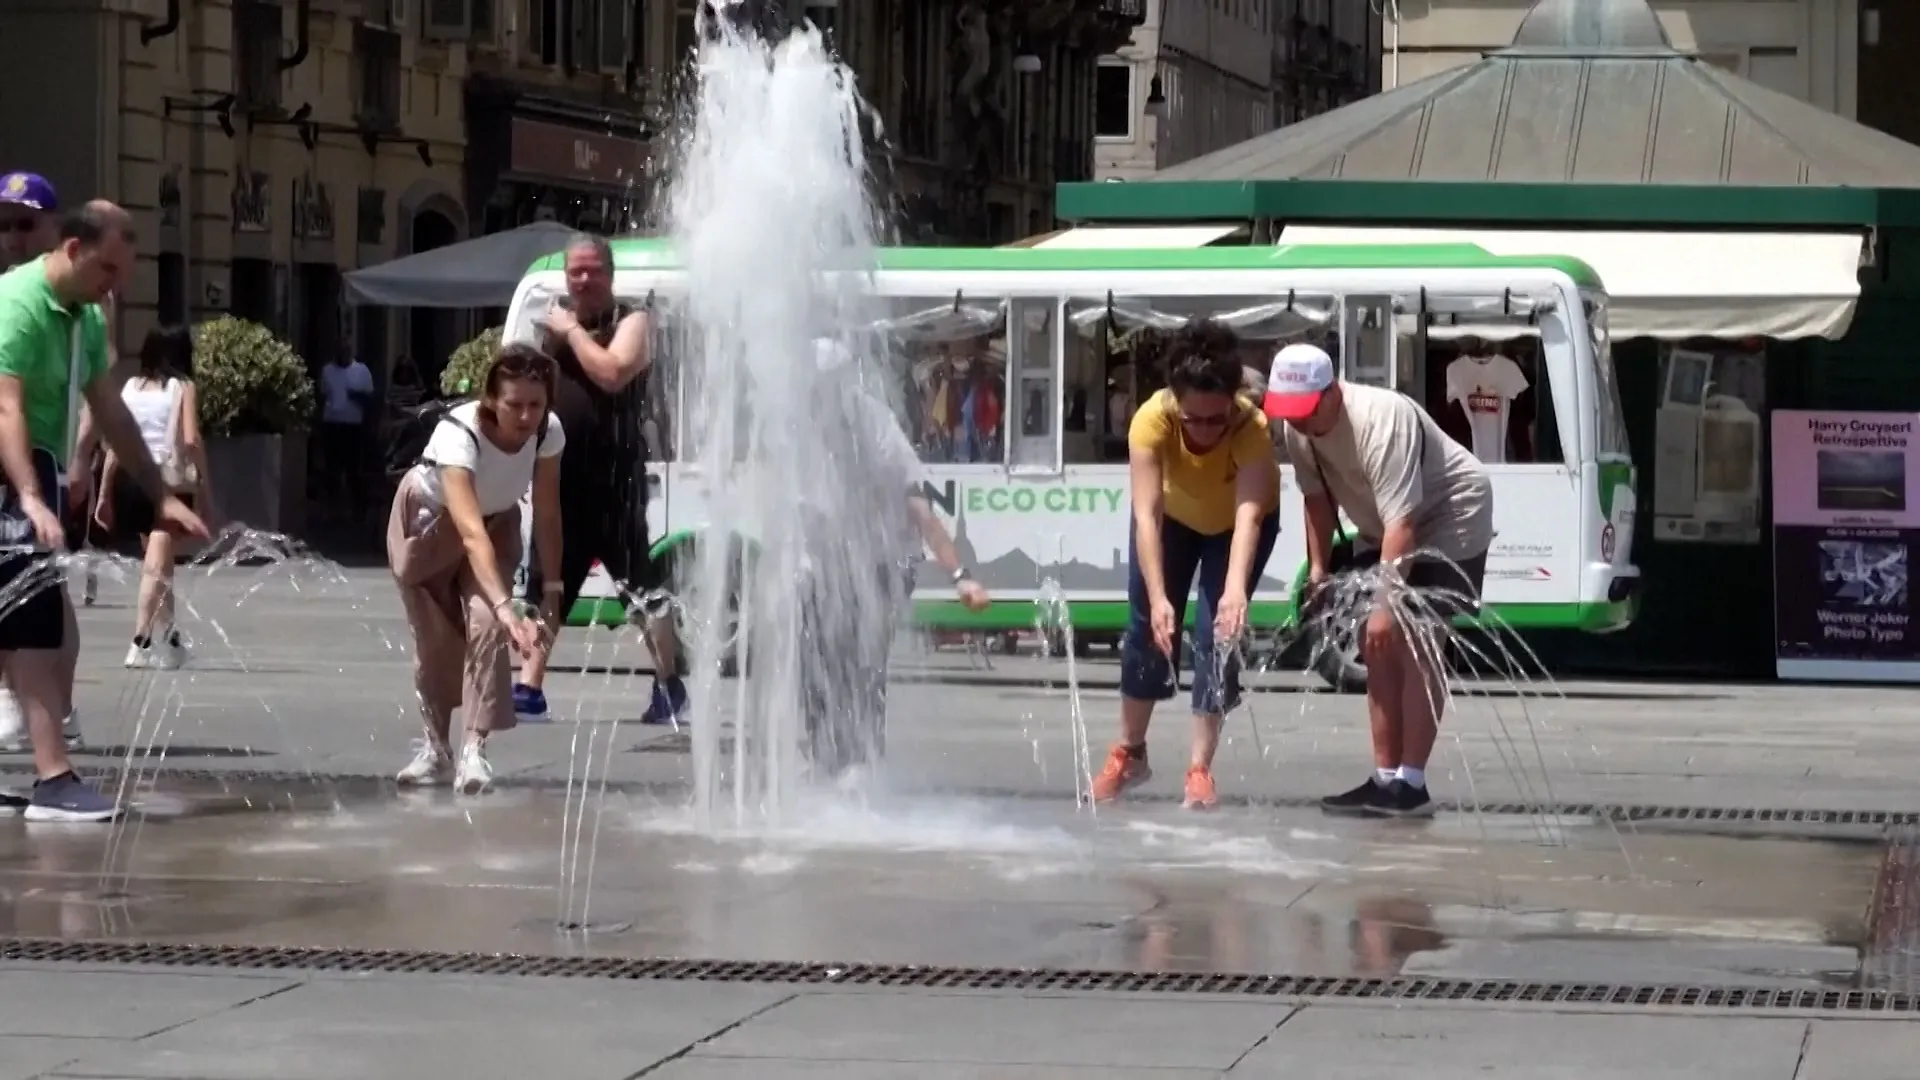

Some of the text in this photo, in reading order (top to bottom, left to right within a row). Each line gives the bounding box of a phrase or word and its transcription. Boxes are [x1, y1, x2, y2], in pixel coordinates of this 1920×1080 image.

[1808, 418, 1847, 432] Harry
[967, 487, 1036, 512] ECO
[1044, 487, 1123, 512] CITY
